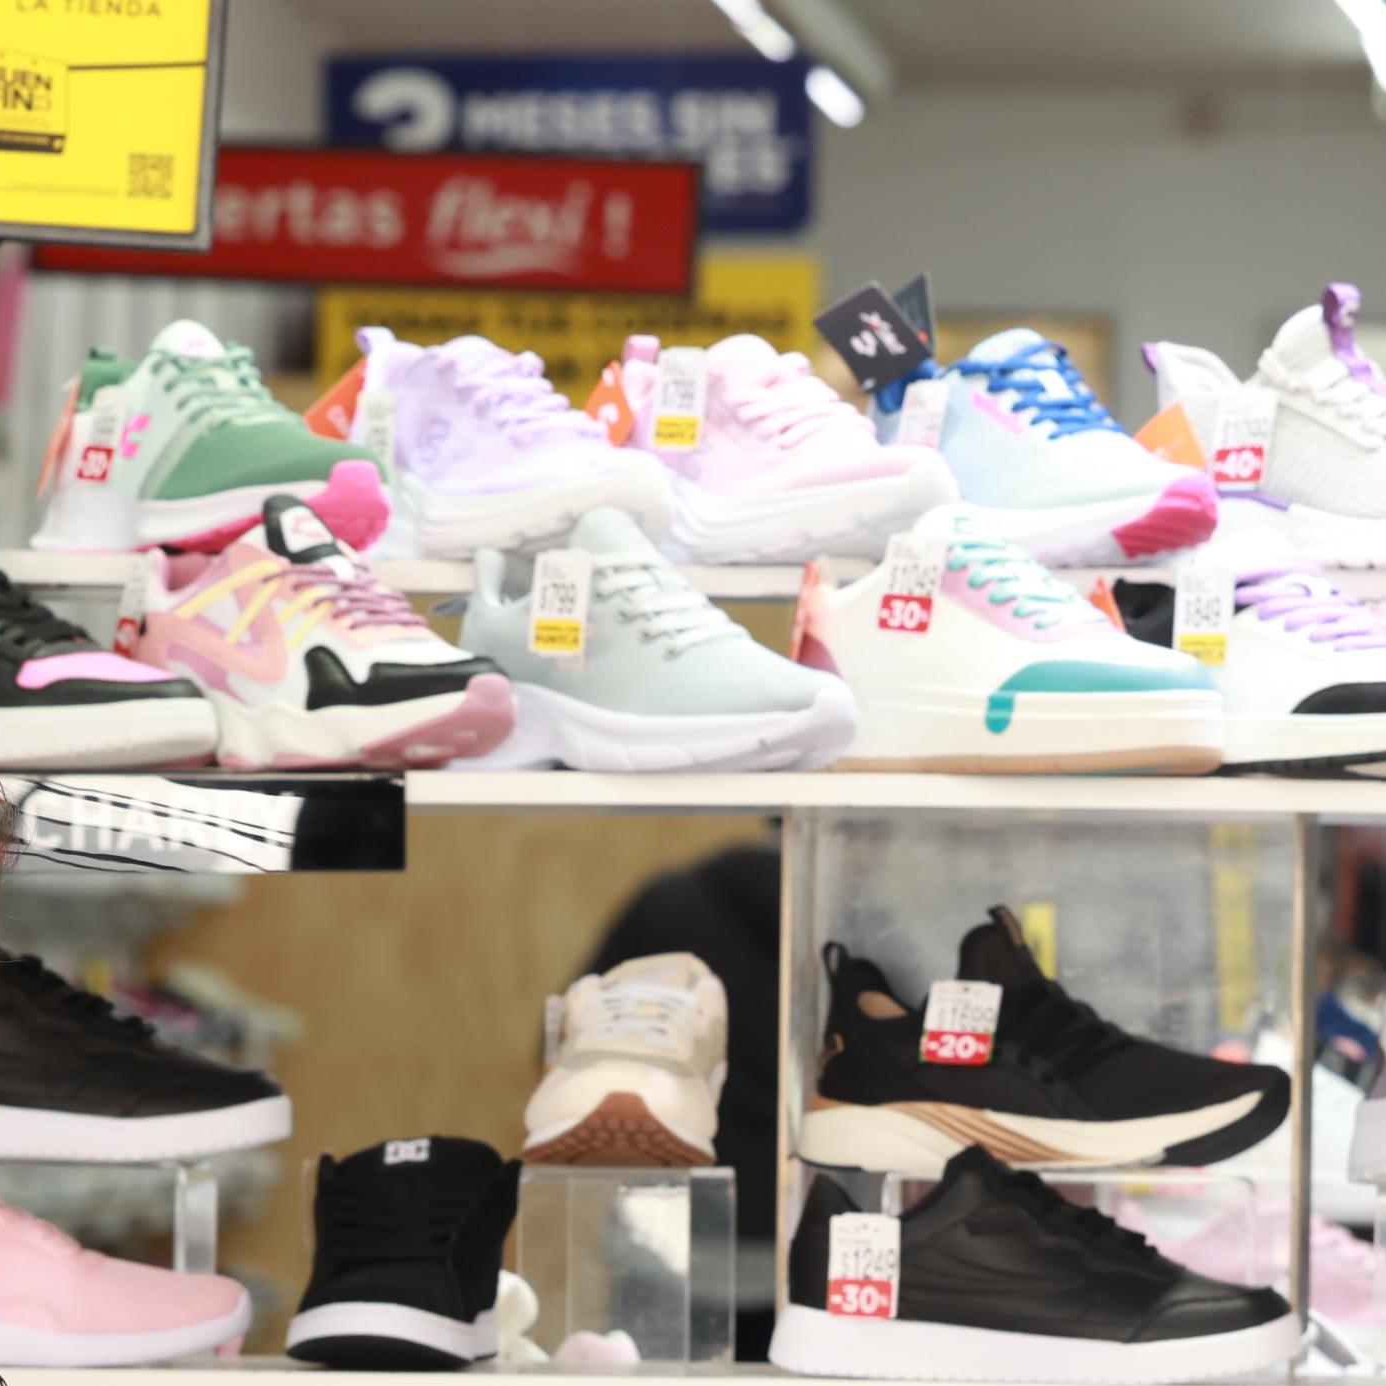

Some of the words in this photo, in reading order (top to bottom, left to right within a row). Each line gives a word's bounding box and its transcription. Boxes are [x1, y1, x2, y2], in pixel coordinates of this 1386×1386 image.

[671, 88, 775, 146] SIN
[215, 182, 401, 246] ertas
[21, 791, 295, 857] CHARLY
